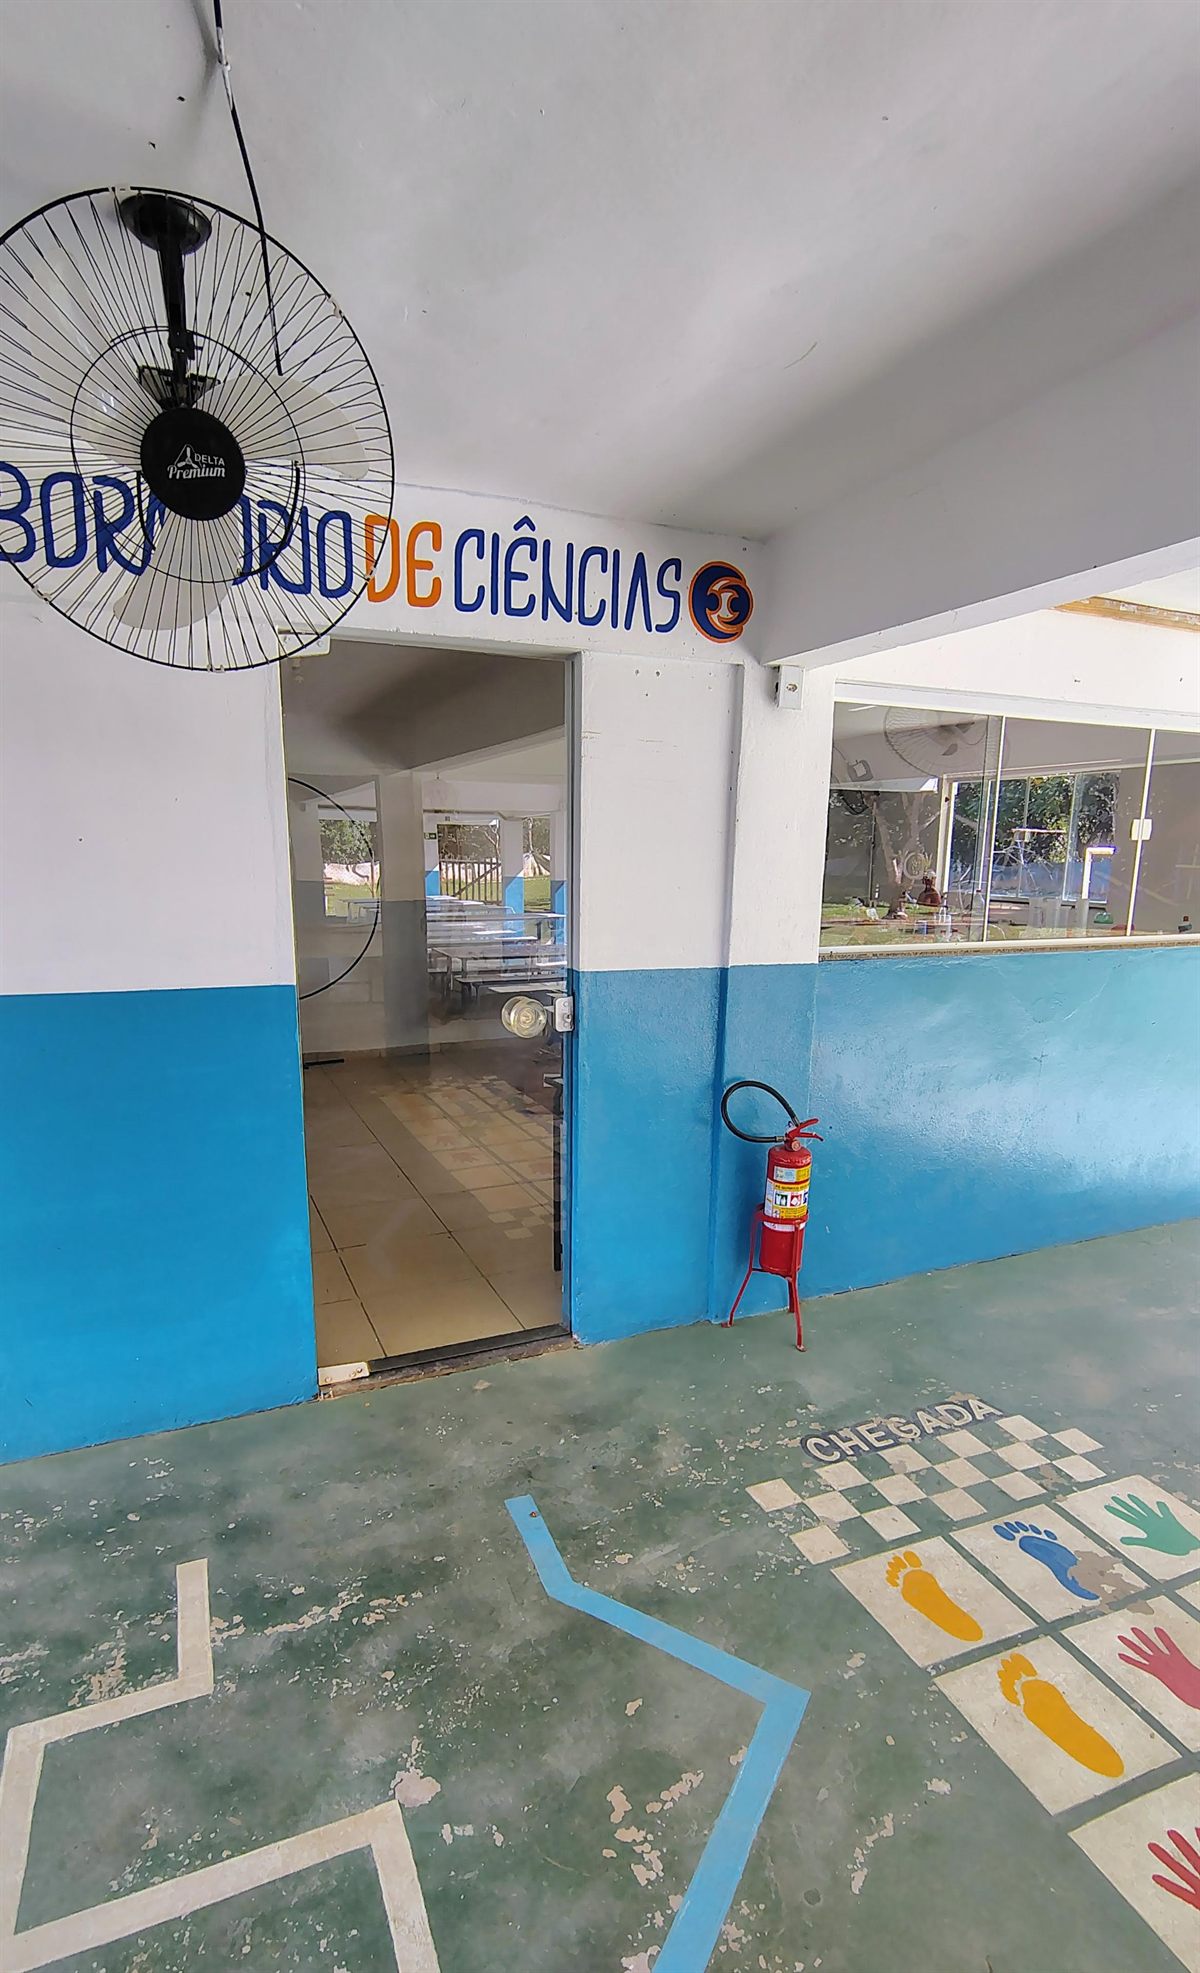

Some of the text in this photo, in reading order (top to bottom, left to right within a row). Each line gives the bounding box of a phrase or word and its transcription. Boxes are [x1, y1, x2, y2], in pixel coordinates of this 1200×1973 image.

[167, 464, 226, 479] Premium
[194, 453, 225, 466] DELTA
[364, 514, 443, 608] DE
[454, 515, 682, 633] CIÊNCIAS
[804, 1399, 1004, 1463] CHEGADA
